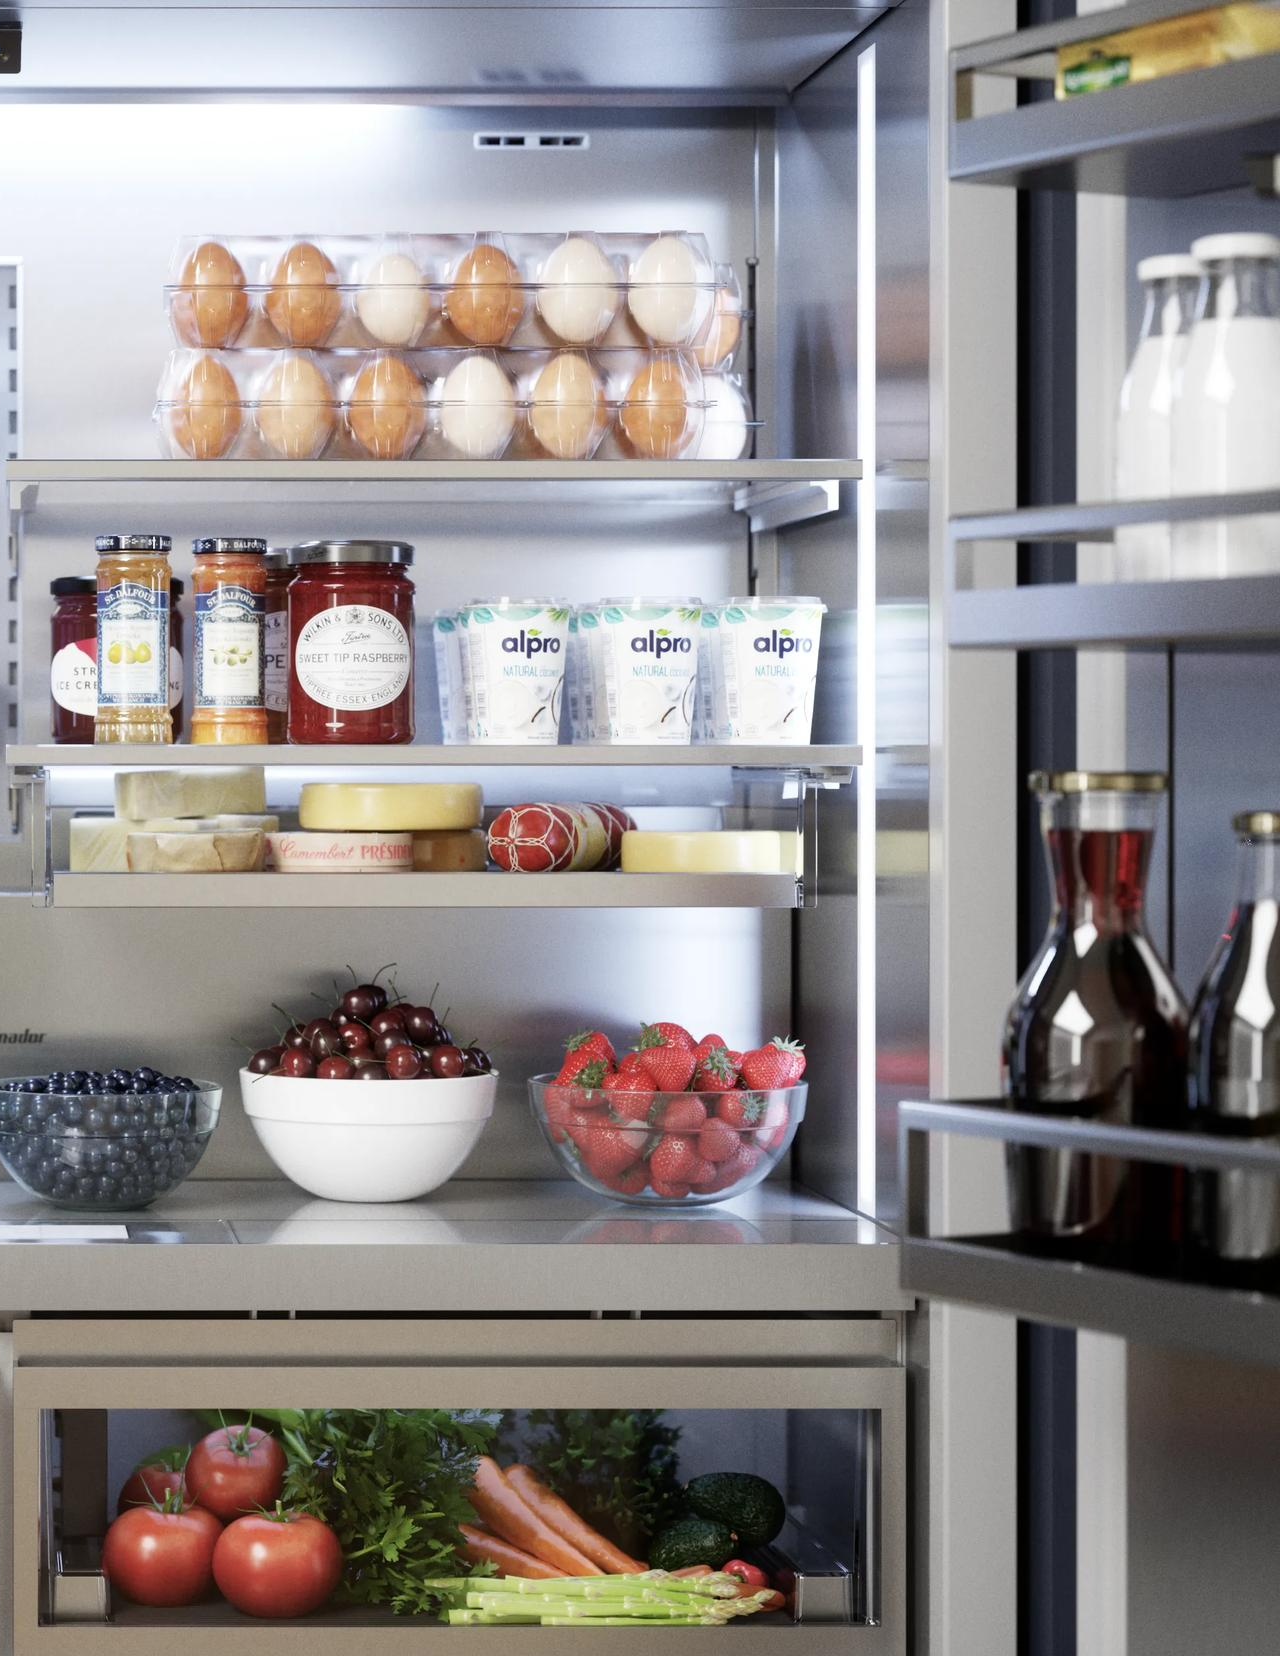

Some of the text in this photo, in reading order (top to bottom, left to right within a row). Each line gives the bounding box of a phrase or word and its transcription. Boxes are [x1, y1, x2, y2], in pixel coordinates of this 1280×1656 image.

[304, 616, 332, 642] WILKIN
[368, 612, 393, 630] SONS
[501, 630, 560, 659] alpro
[631, 630, 691, 658] alpro
[753, 630, 813, 658] alpro
[298, 653, 408, 664] SWEET TIP RASPBERRY
[503, 665, 538, 677] NATURAL
[632, 665, 668, 677] NATURAL
[754, 665, 791, 677] NATURAL
[336, 695, 368, 705] ESSEX
